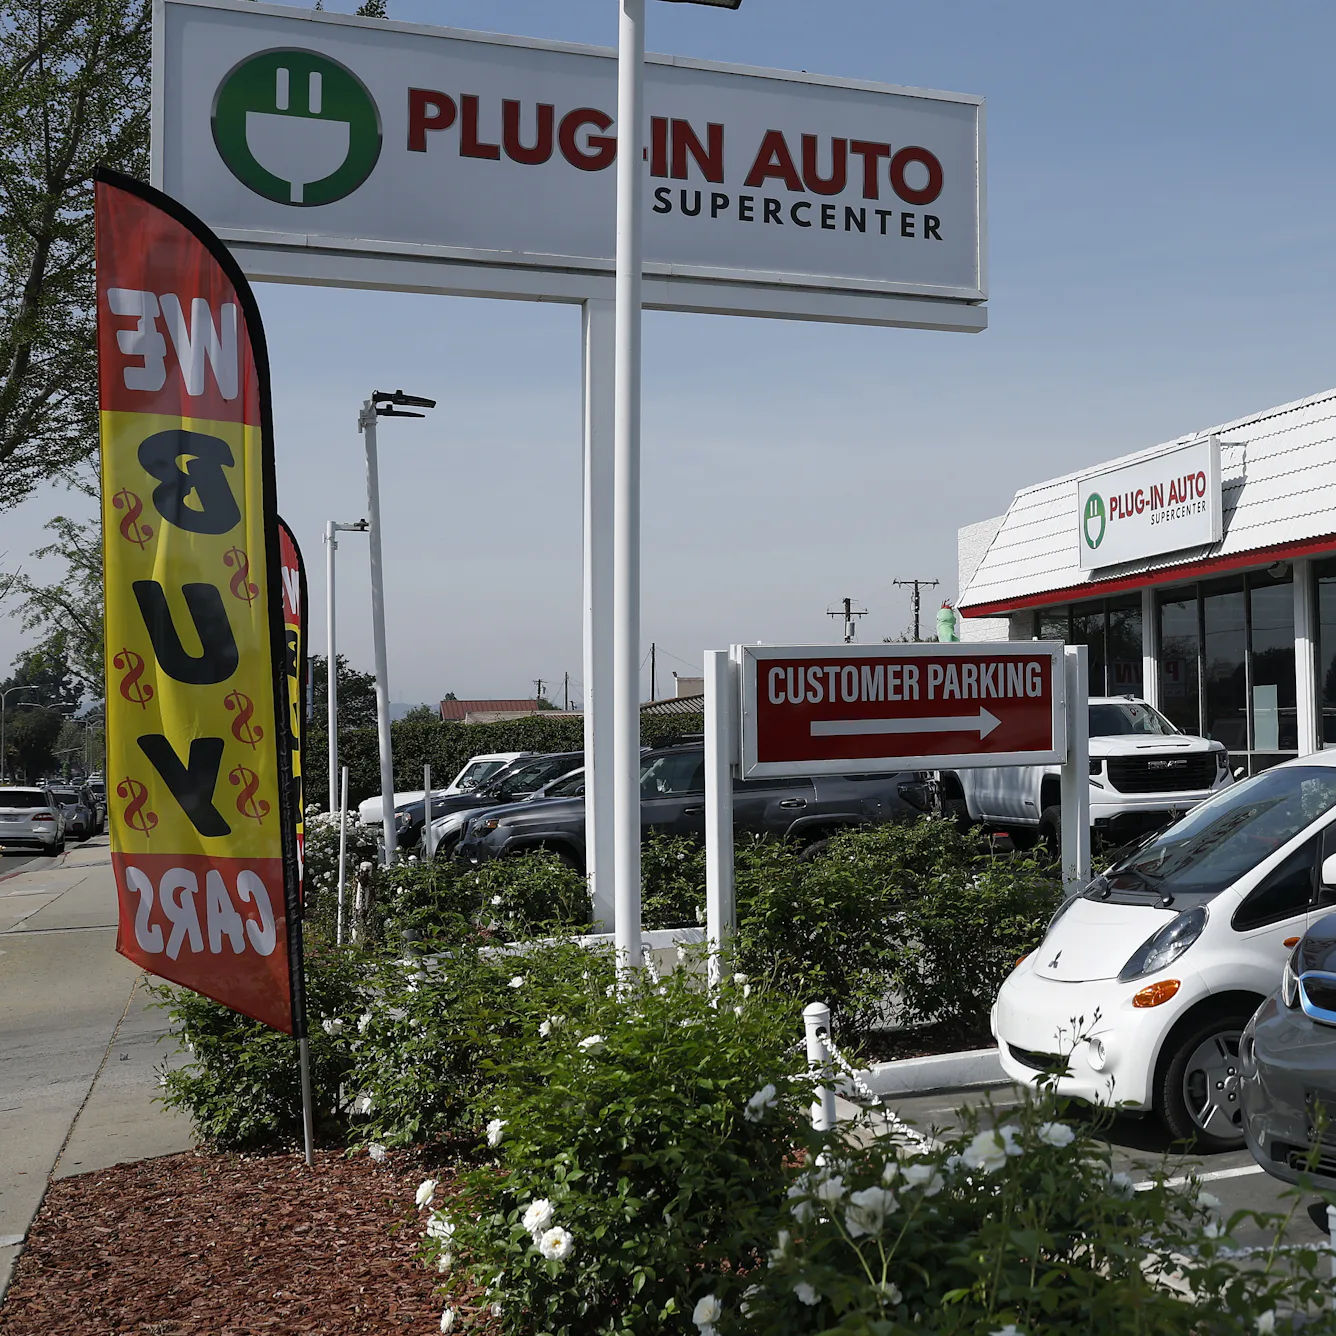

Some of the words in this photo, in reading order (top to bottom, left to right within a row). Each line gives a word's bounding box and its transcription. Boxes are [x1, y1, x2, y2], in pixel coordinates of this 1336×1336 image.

[407, 86, 725, 183] PLUGIN
[744, 128, 944, 206] AUTO
[652, 186, 945, 241] SUPERCENTER
[1109, 483, 1164, 522] PLUG-IN
[1168, 471, 1207, 507] AUTO
[1150, 500, 1207, 526] SUPERCENTER
[767, 664, 920, 705] CUSTOMER
[927, 661, 1043, 700] PARKING
